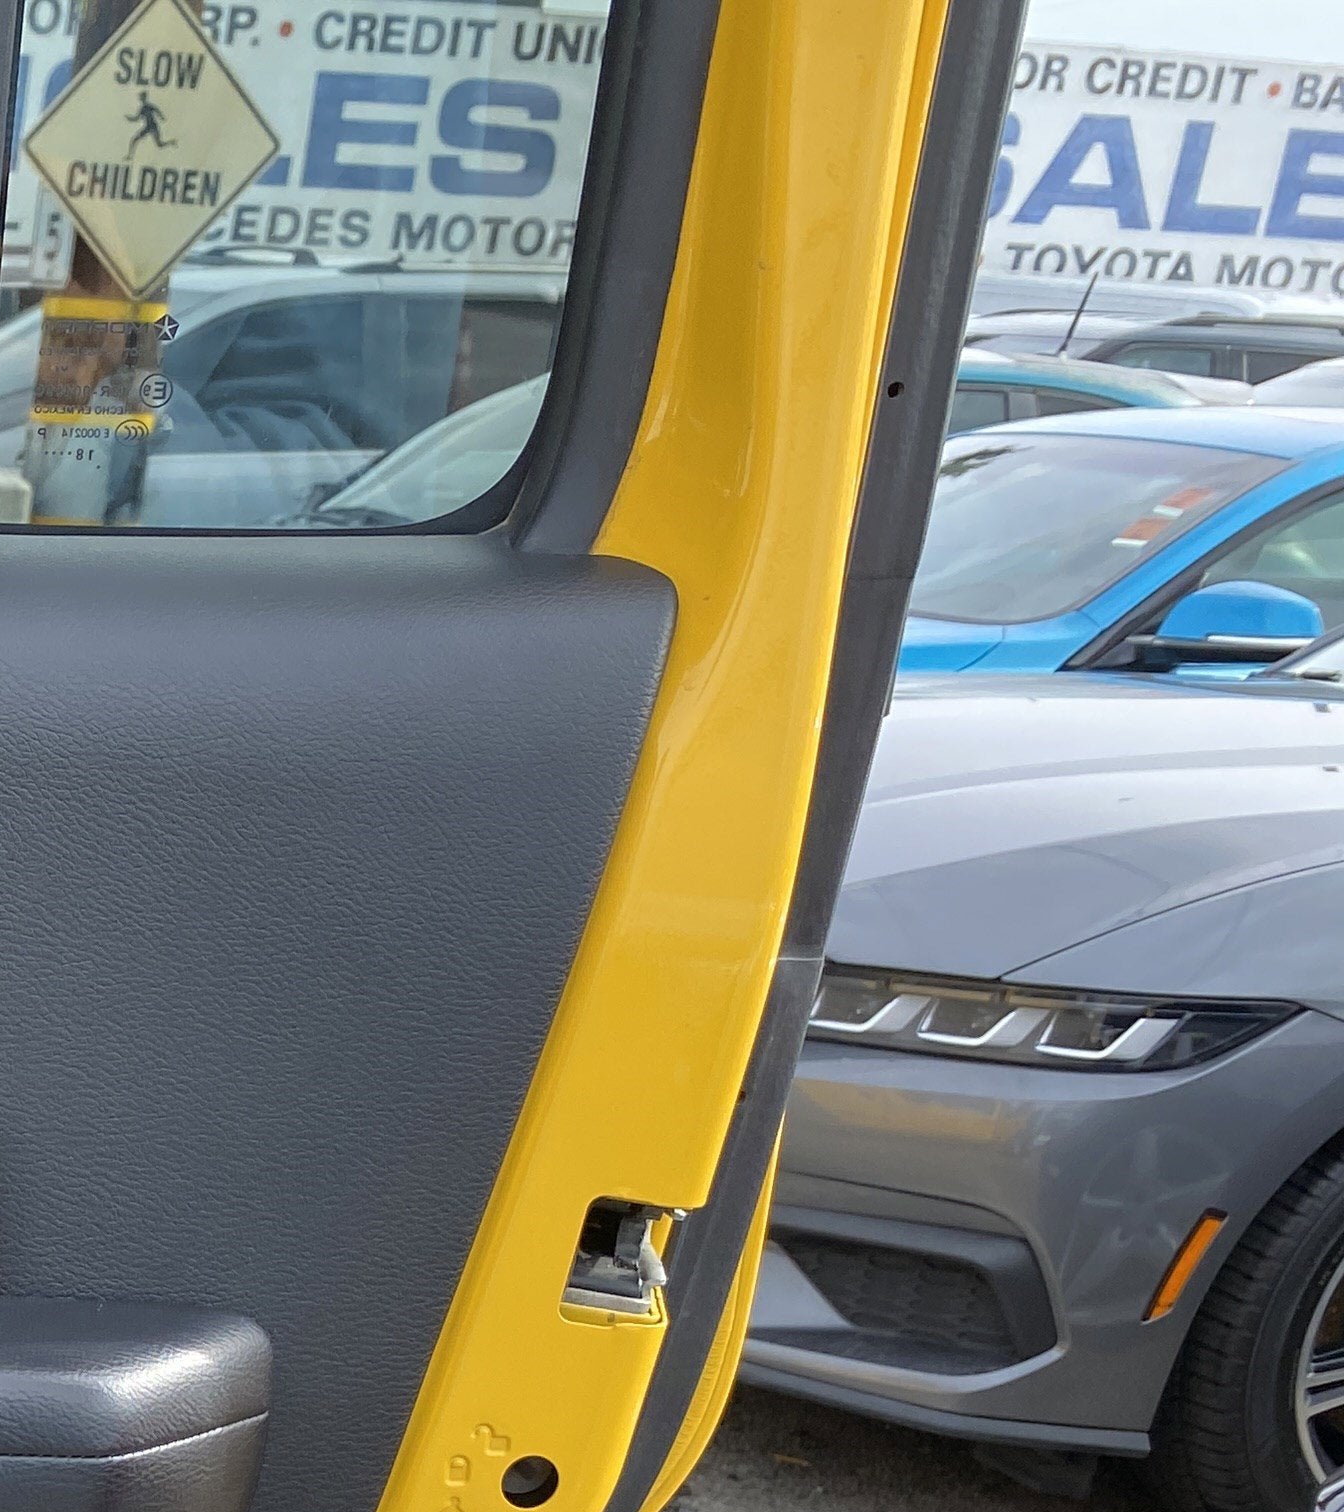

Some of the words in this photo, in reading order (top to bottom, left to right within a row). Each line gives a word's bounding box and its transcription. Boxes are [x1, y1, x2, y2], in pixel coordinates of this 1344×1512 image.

[201, 5, 259, 46] RP.
[314, 9, 497, 58] CREDIT
[511, 21, 605, 65] UNI
[114, 46, 204, 90] SLOW
[1085, 56, 1258, 105] CREDIT
[66, 159, 221, 207] CHILDREN
[988, 111, 1344, 240] ALE
[1006, 241, 1194, 282] TOYOTA
